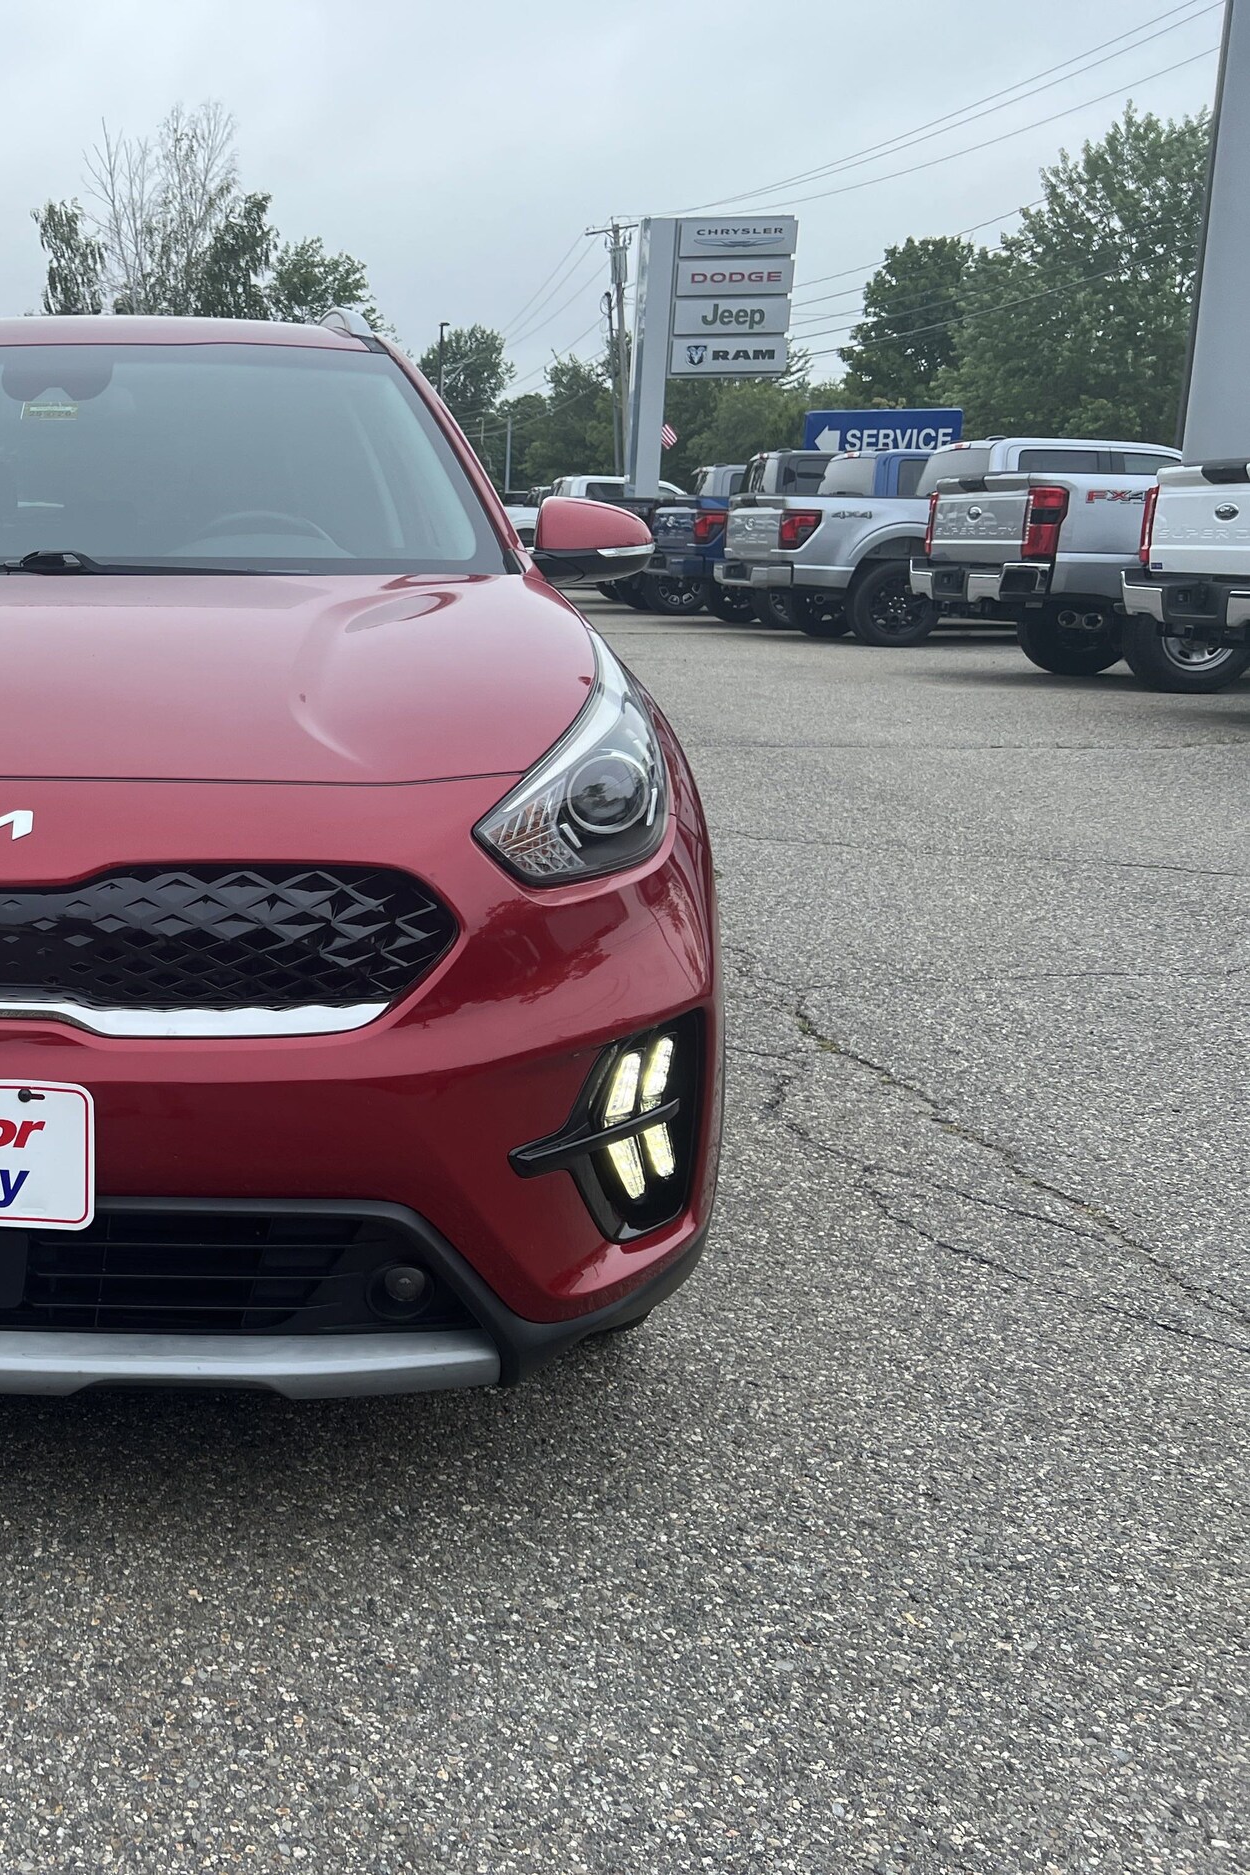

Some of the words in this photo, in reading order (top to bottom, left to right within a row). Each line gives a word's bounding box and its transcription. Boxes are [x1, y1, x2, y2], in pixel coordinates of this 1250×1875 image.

[696, 227, 784, 236] CHRYSLER
[691, 271, 783, 284] DODGE
[701, 303, 766, 330] Jeep
[711, 349, 776, 361] RAM
[845, 428, 953, 450] SERVICE
[1085, 489, 1147, 504] FX4
